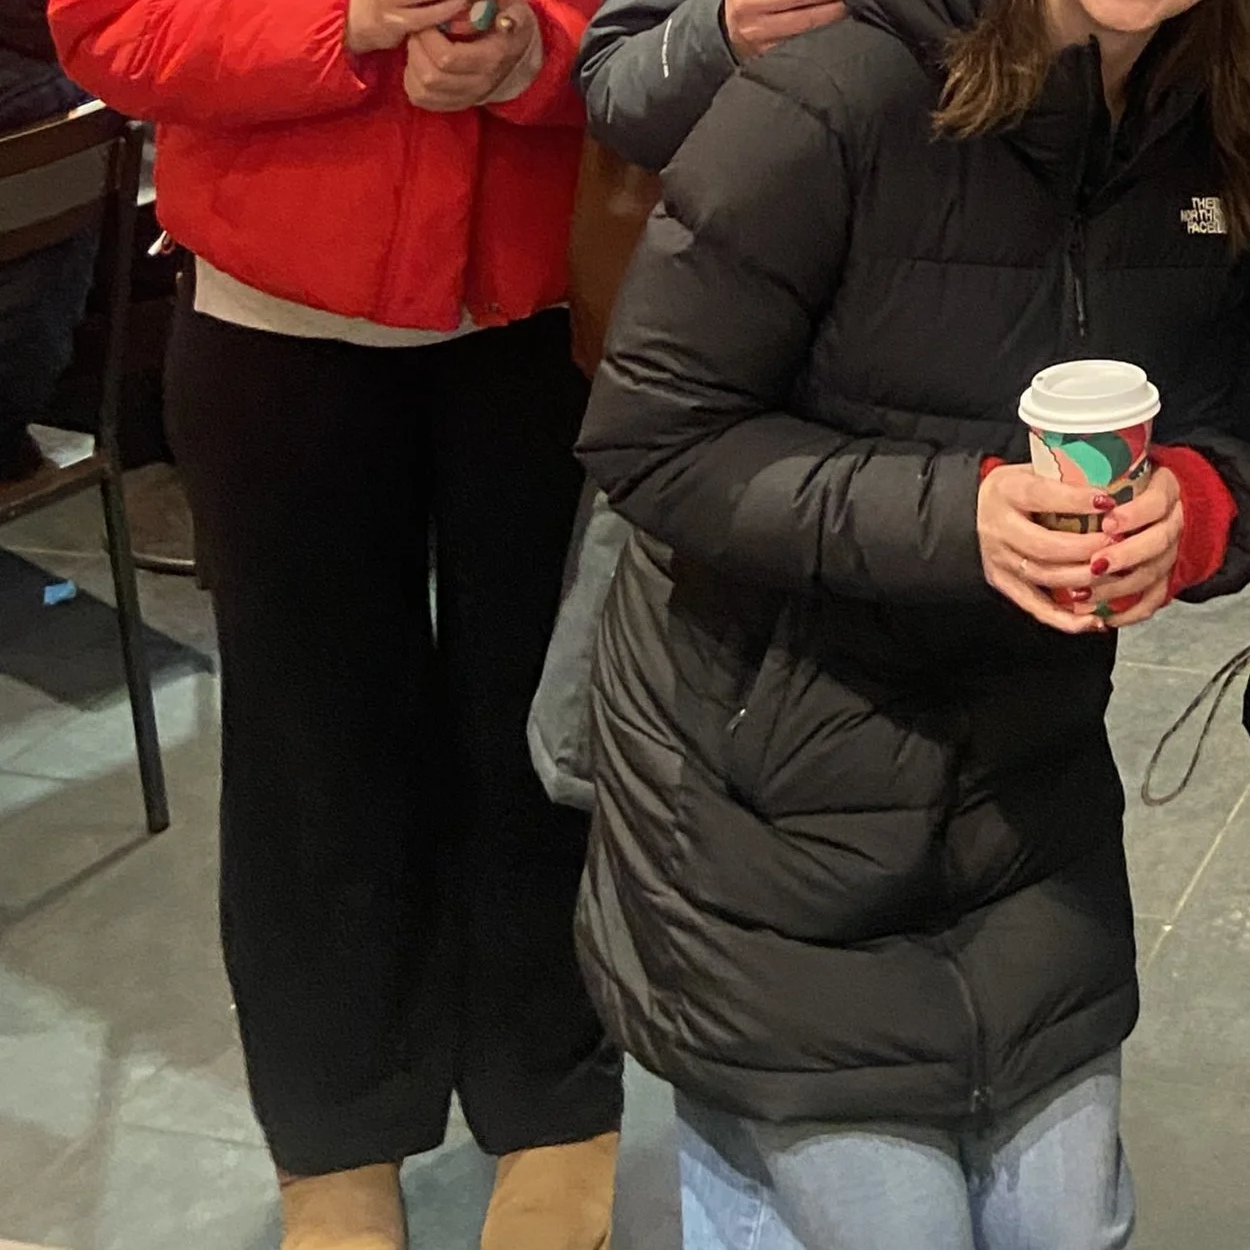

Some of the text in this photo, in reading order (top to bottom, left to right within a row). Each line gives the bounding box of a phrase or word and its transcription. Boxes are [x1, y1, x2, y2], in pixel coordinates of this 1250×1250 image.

[1191, 197, 1215, 210] THE
[1180, 209, 1213, 223] NORTH
[1187, 221, 1216, 234] FACE
